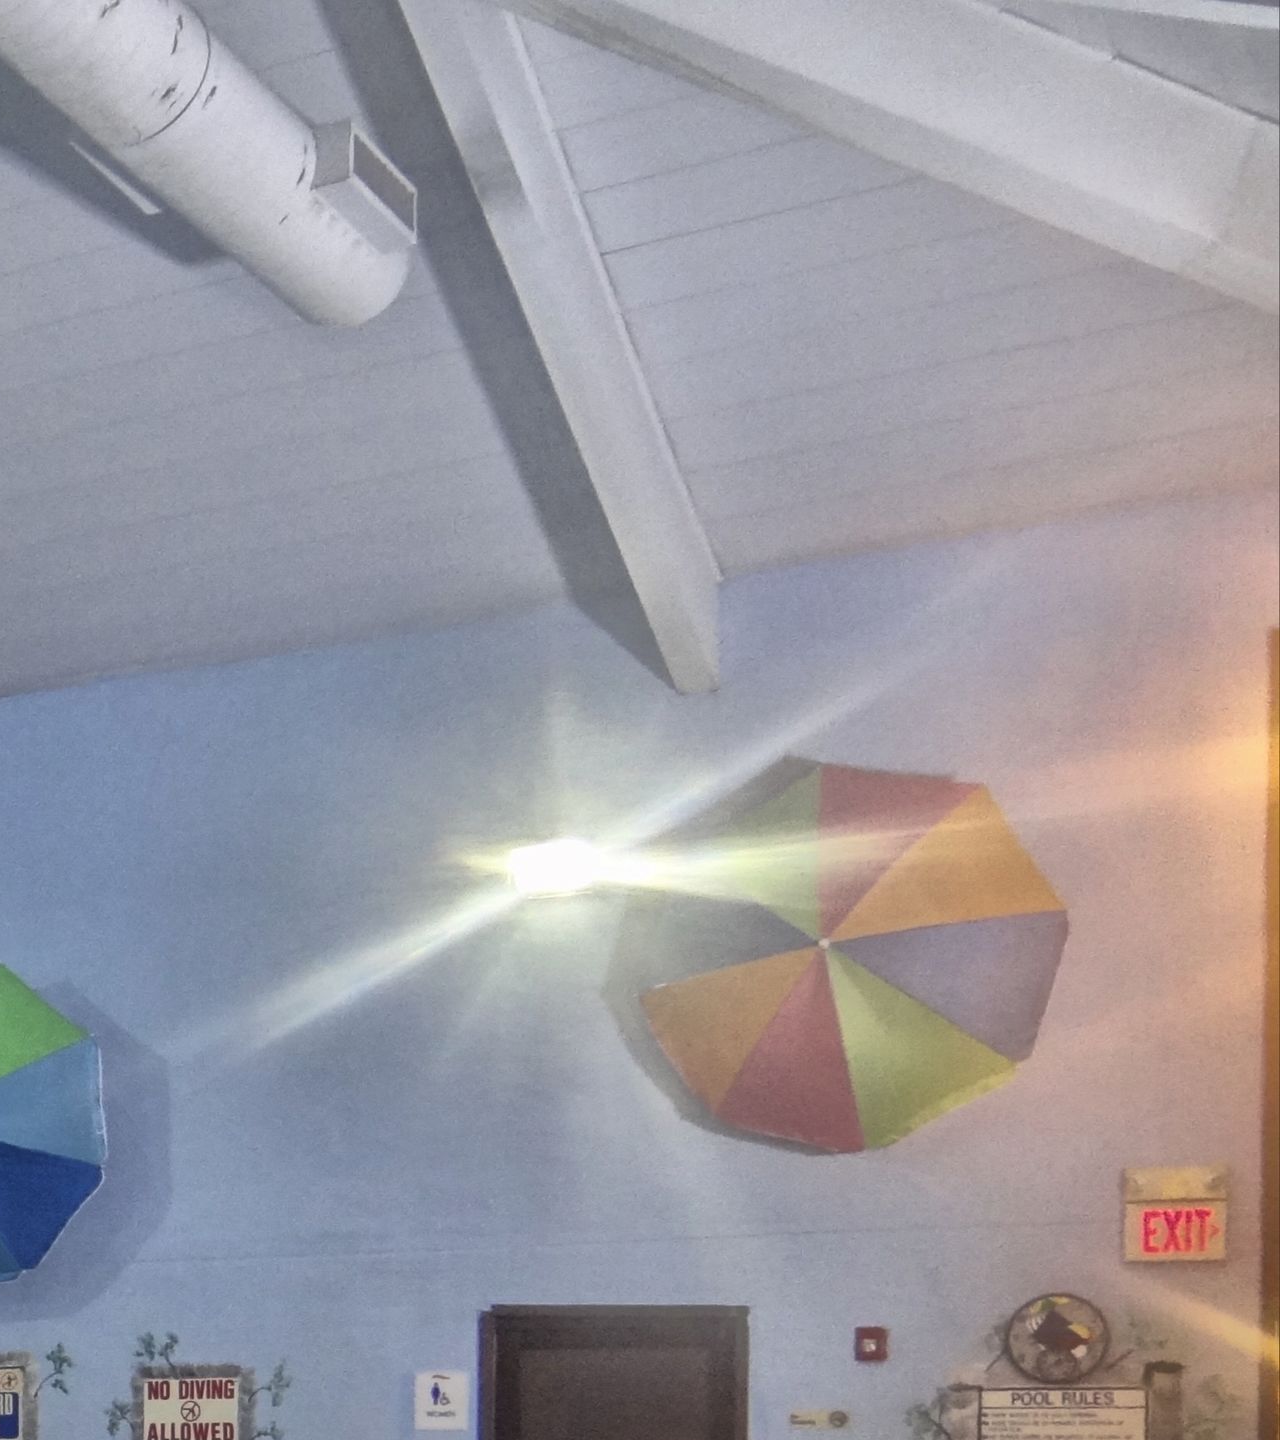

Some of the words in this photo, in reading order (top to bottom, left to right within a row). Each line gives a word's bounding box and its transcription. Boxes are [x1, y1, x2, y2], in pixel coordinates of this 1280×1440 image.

[1144, 1209, 1211, 1253] EXIT
[147, 1381, 170, 1400] NO
[178, 1380, 235, 1399] DIVING
[1011, 1392, 1054, 1406] POOL
[1061, 1391, 1115, 1406] RULES
